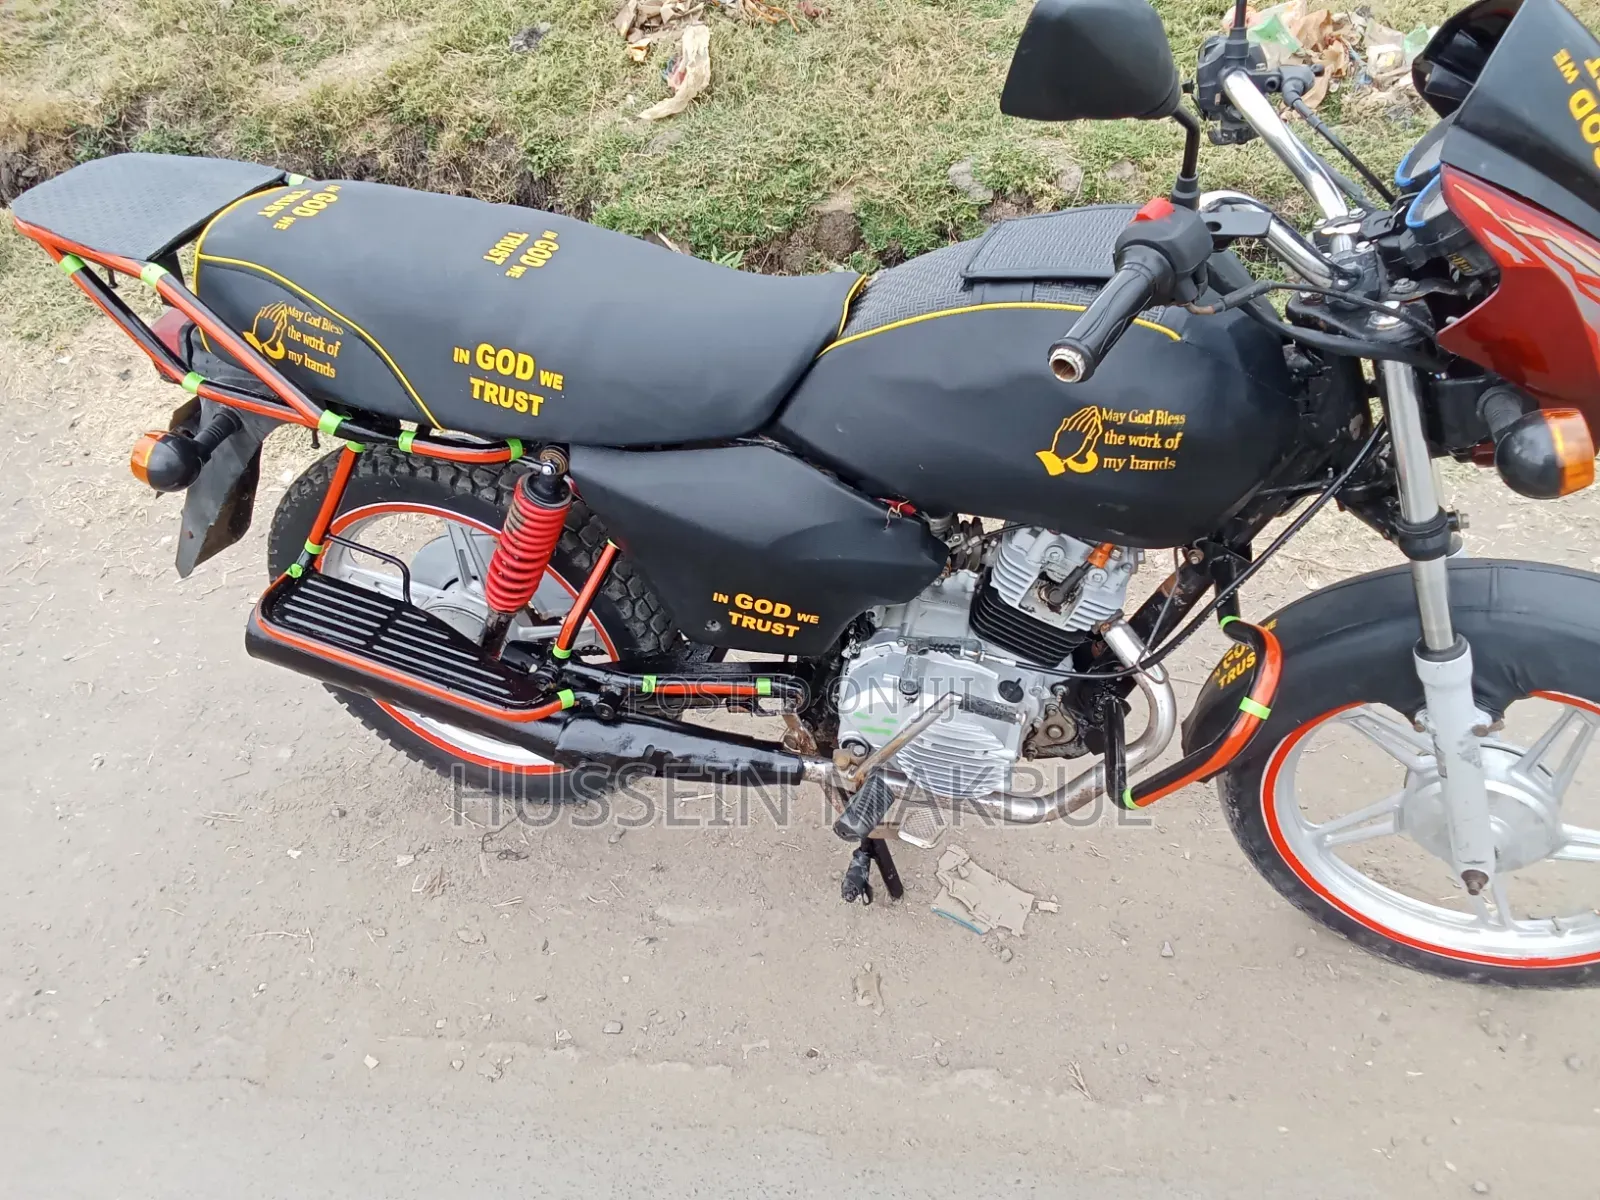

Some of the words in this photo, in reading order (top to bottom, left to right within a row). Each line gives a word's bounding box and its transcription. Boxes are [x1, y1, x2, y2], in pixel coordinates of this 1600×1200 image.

[1552, 48, 1580, 84] WE
[257, 189, 312, 218] TRUST
[291, 192, 338, 217] GOD
[272, 216, 297, 230] WE
[541, 229, 559, 240] IN
[482, 231, 529, 266] TRUST
[519, 239, 560, 268] GOD
[504, 264, 528, 279] WE
[286, 305, 304, 322] May
[304, 311, 322, 329] God
[321, 317, 344, 336] Bless
[287, 324, 302, 342] the
[302, 333, 327, 353] work
[327, 340, 342, 358] of
[287, 350, 303, 366] my
[304, 352, 336, 378] hands
[453, 346, 471, 365] IN
[475, 342, 535, 381] GOD
[540, 369, 564, 391] WE
[469, 376, 544, 417] TRUST
[1101, 407, 1127, 425] May
[1128, 409, 1154, 425] God
[1156, 409, 1187, 426] Bless
[1104, 429, 1126, 446] the
[1128, 430, 1162, 449] work
[1164, 431, 1184, 451] of
[1103, 456, 1127, 472] my
[1129, 455, 1177, 471] hands
[712, 591, 729, 604] IN
[734, 592, 792, 619] GOD
[797, 612, 820, 625] WE
[728, 611, 800, 638] TRUST
[1222, 642, 1251, 669] GO
[1218, 651, 1257, 690] TRUS
